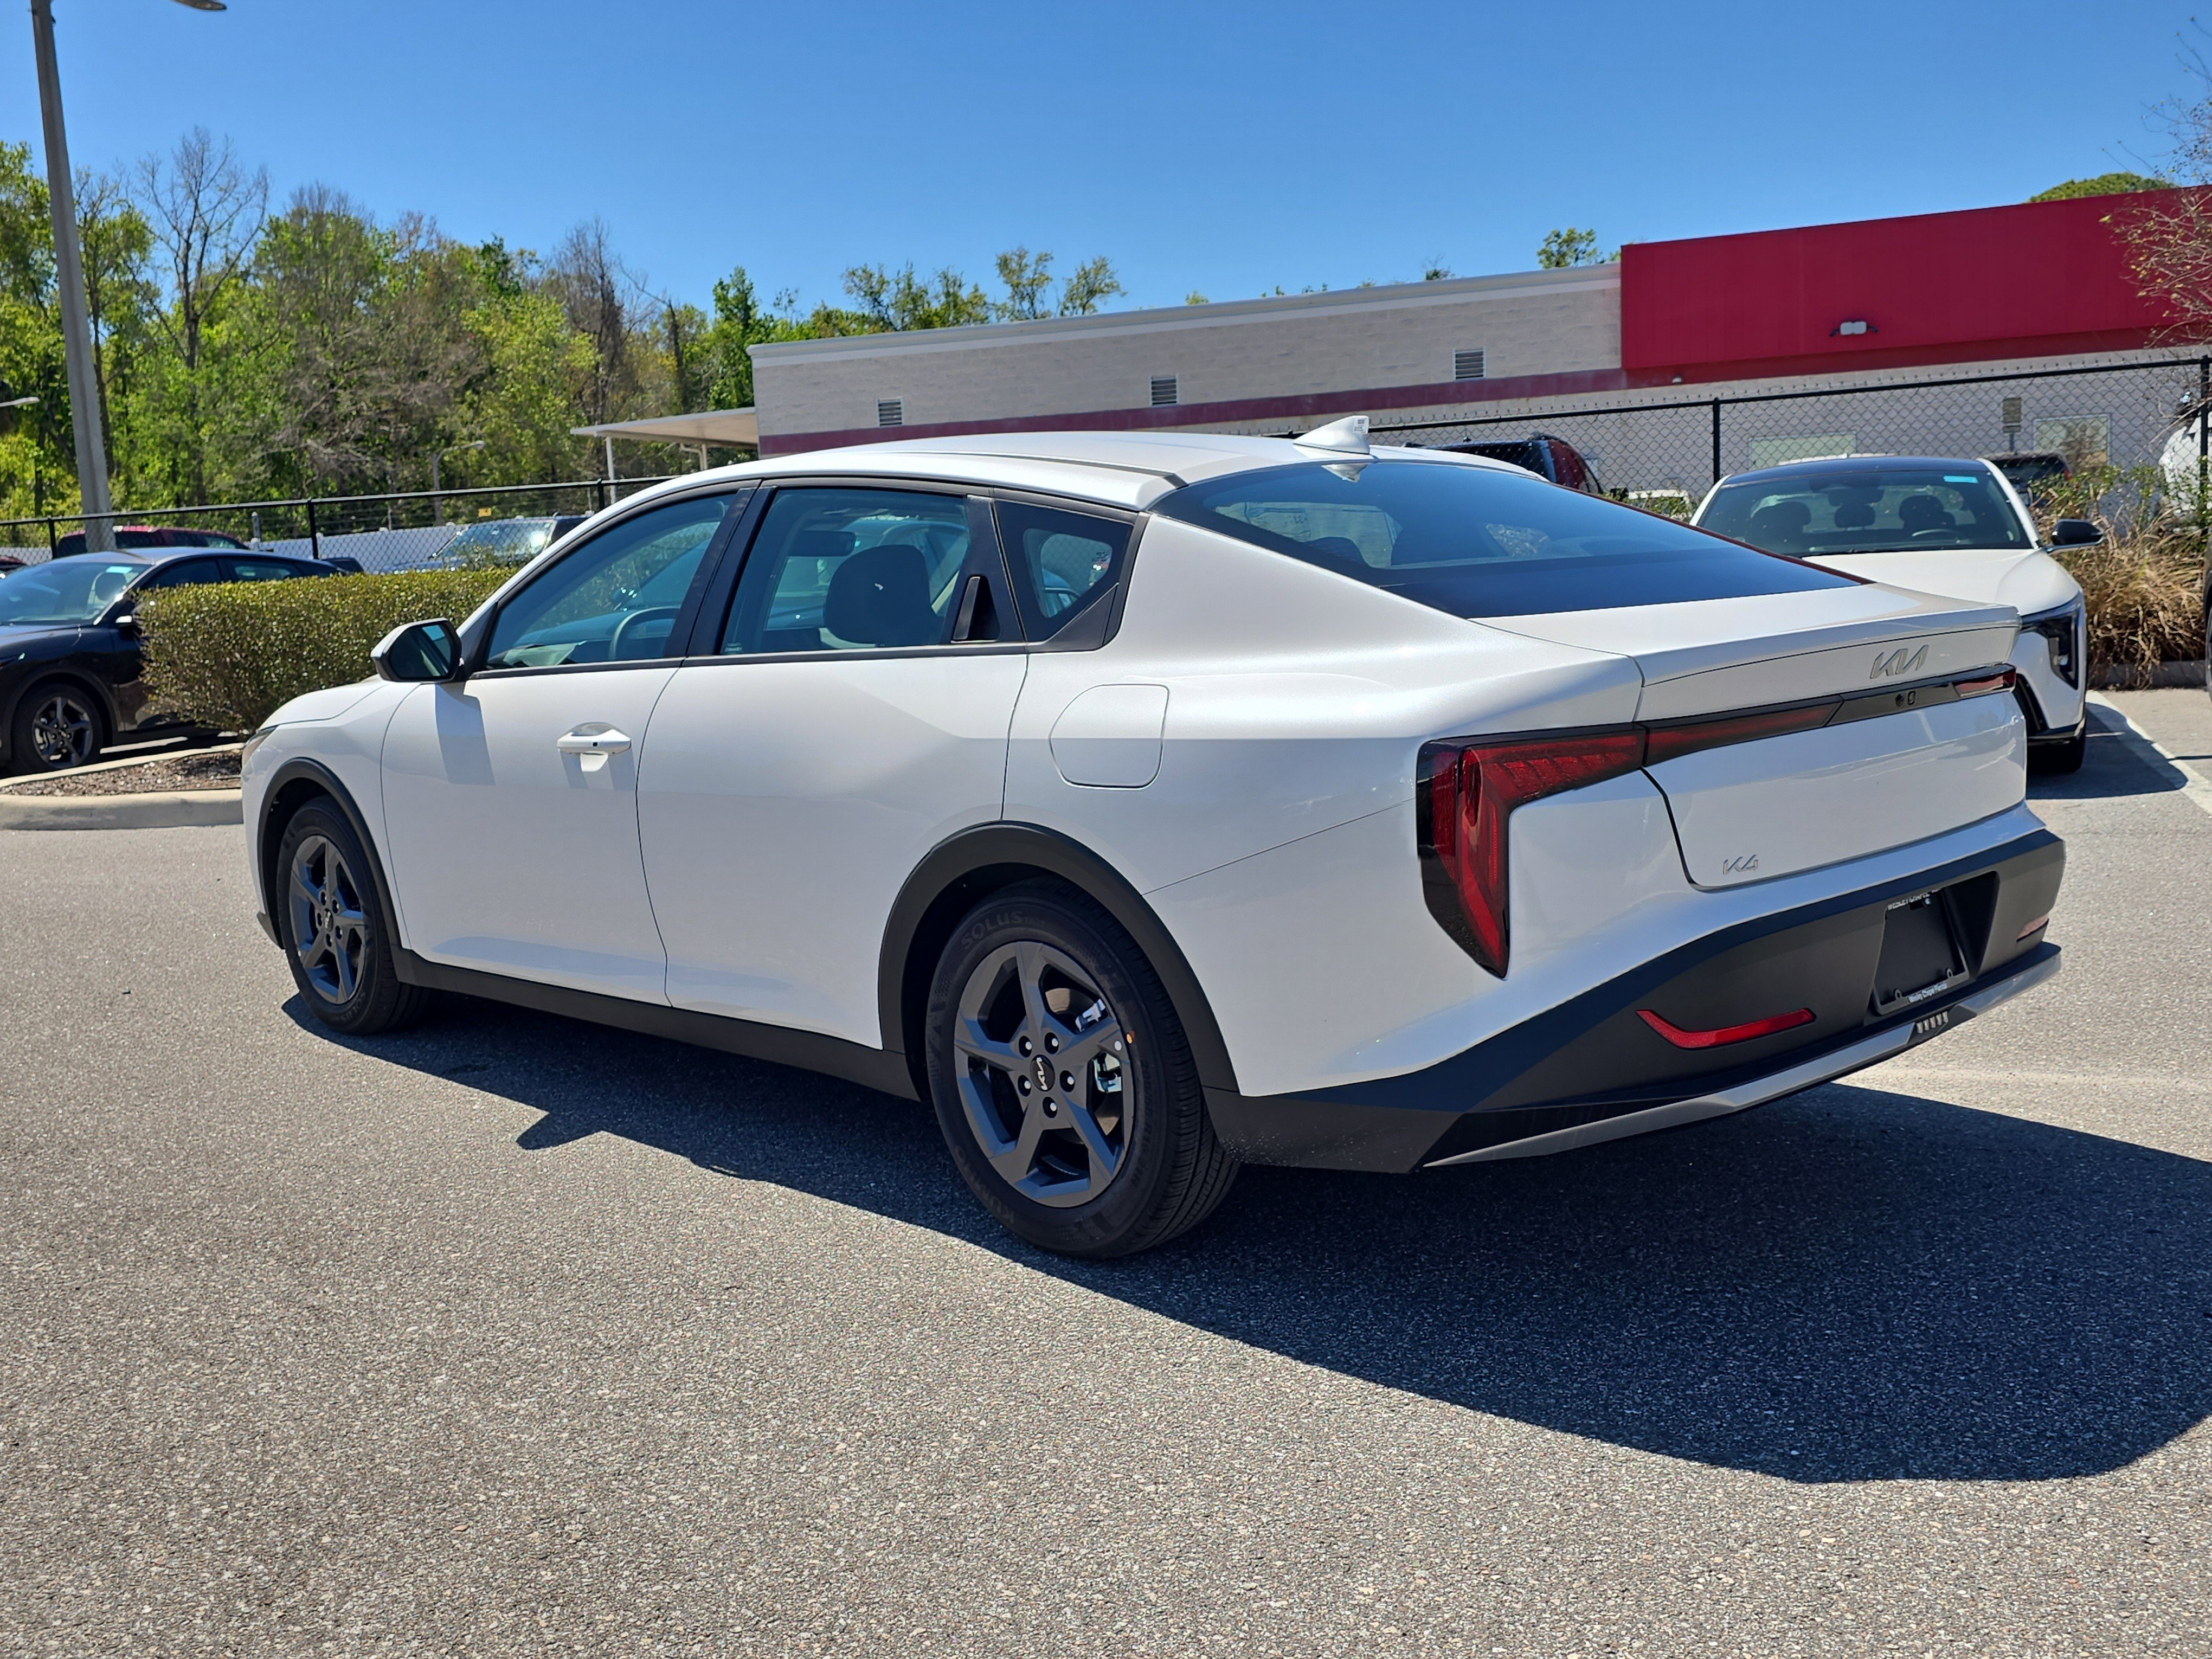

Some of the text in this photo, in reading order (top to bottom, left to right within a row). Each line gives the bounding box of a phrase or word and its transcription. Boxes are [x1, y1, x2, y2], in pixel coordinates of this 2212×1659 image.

[1870, 645, 1929, 679] KIA
[1723, 854, 1758, 875] K4
[961, 911, 1023, 949] SOLUS
